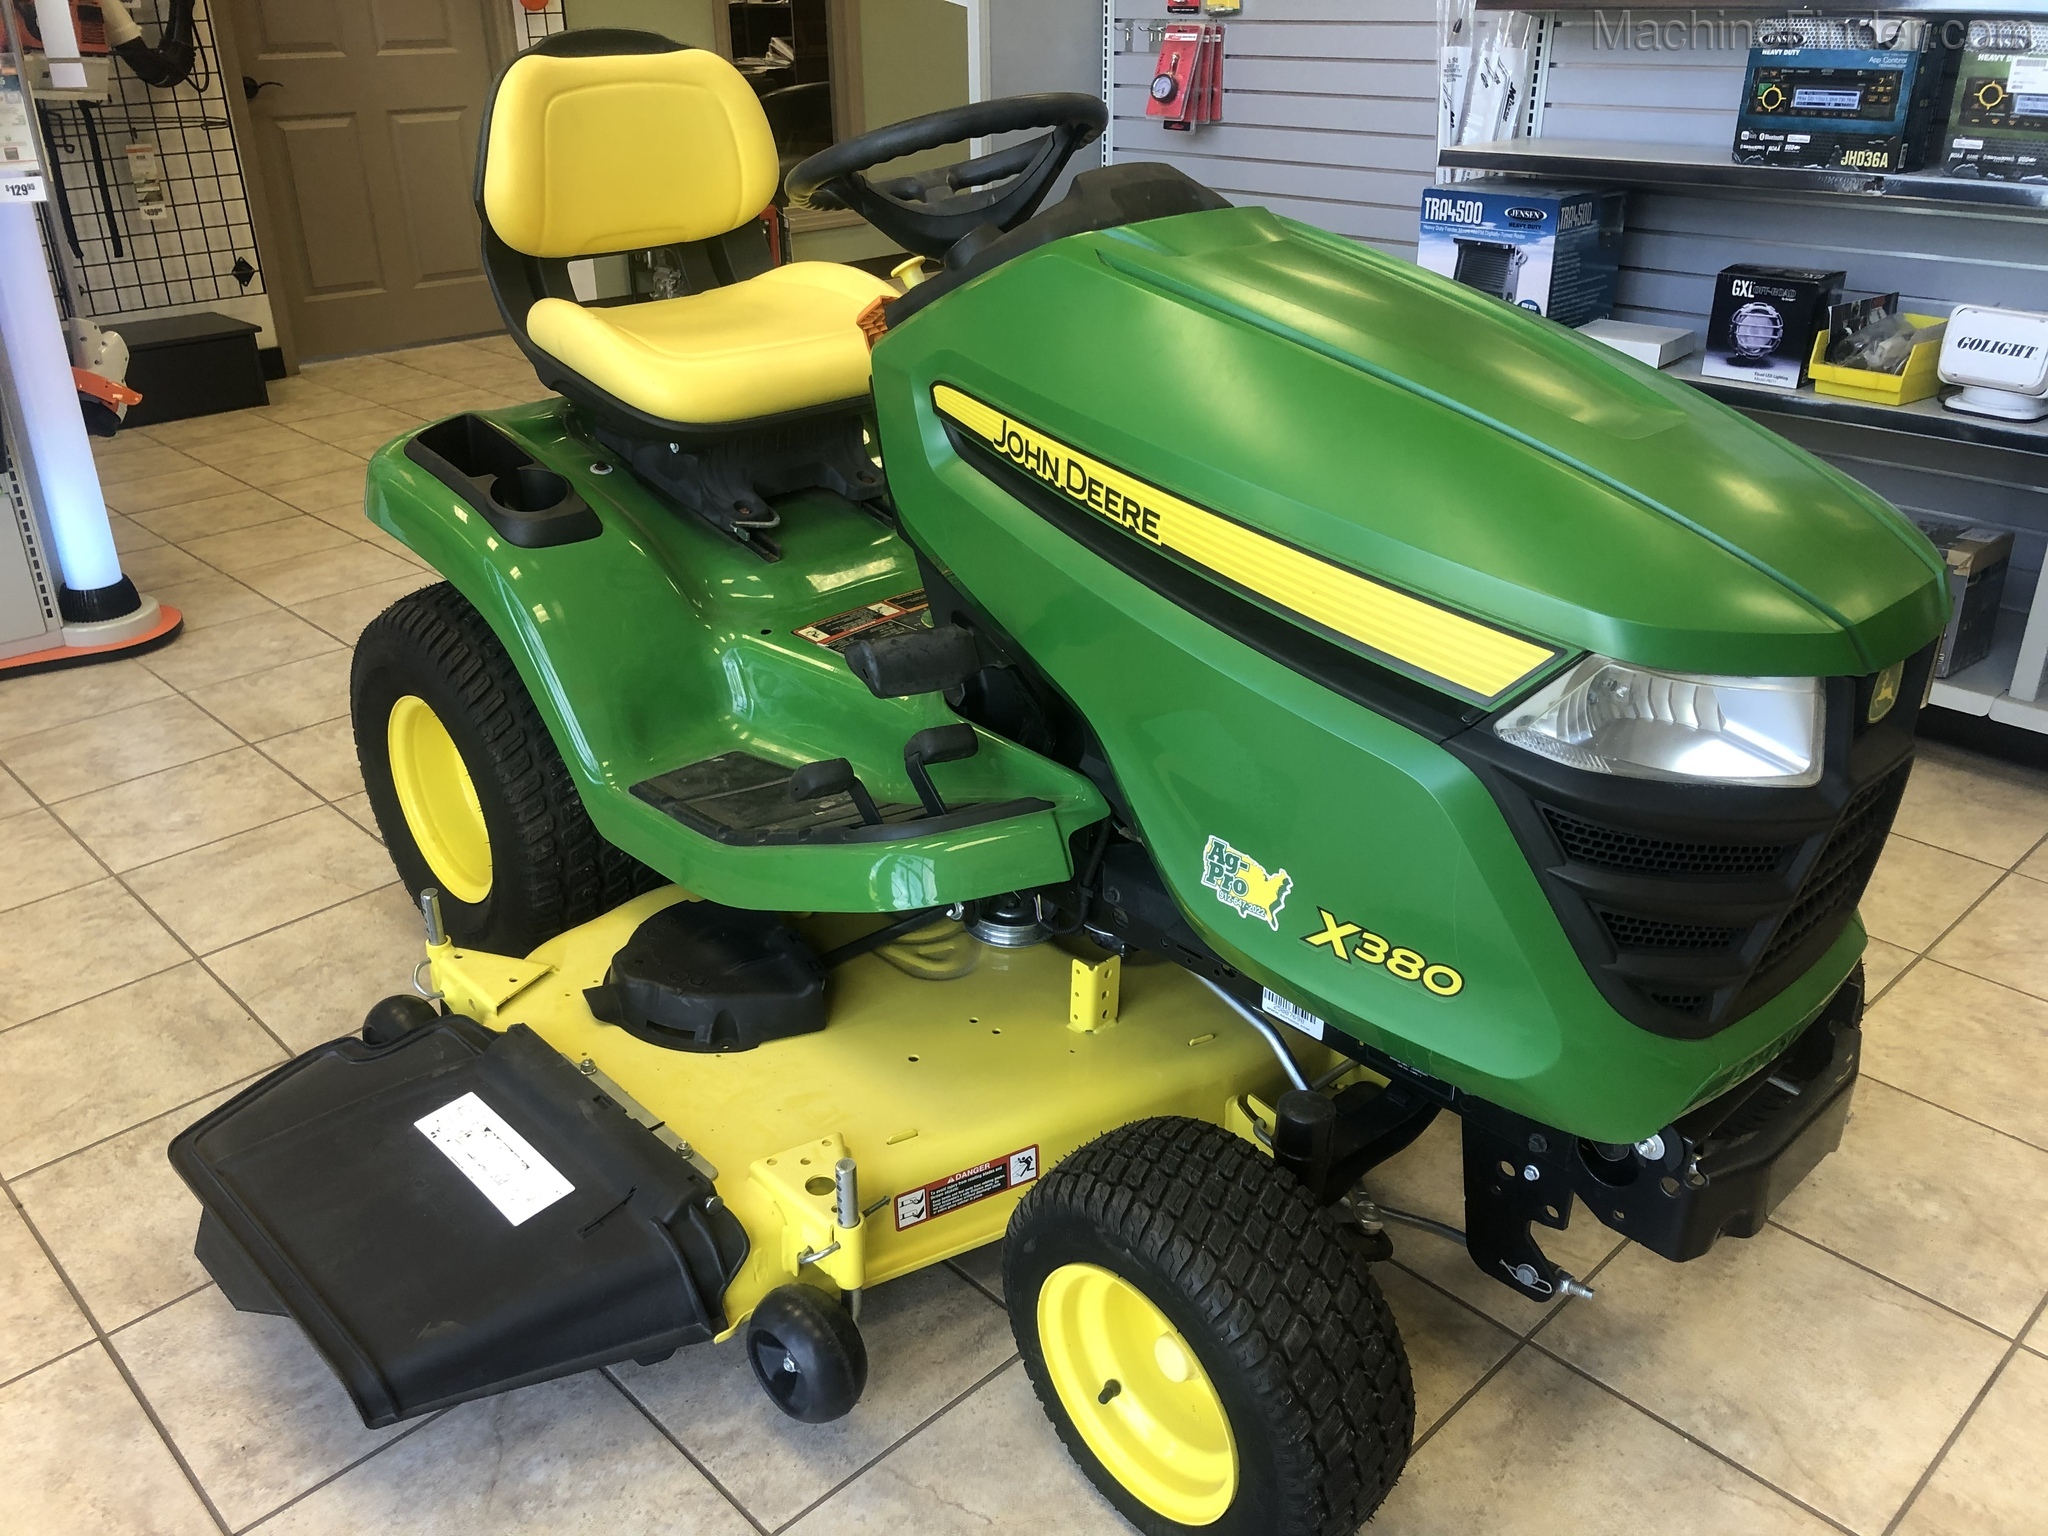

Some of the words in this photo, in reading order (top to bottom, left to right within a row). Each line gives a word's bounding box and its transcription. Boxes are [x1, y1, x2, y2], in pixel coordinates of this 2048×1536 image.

[1764, 34, 1800, 44] JENSEN
[1868, 56, 1882, 64] App
[1883, 56, 1908, 64] Control
[1977, 53, 2006, 62] HEAVY
[1841, 151, 1888, 168] JHD36A
[1424, 197, 1483, 225] TRA4500
[1509, 208, 1541, 220] JENSEN
[1560, 201, 1593, 230] TRA4500
[1731, 279, 1755, 298] GXL
[1753, 285, 1797, 298] OFF-ROAD
[1957, 336, 2039, 359] GOLIGHT
[993, 419, 1060, 484] JOHN
[1066, 457, 1161, 542] DEERE
[1207, 840, 1248, 875] Ag-
[1205, 860, 1247, 896] Pro
[1299, 905, 1466, 998] X380
[955, 1162, 990, 1180] DANGER
